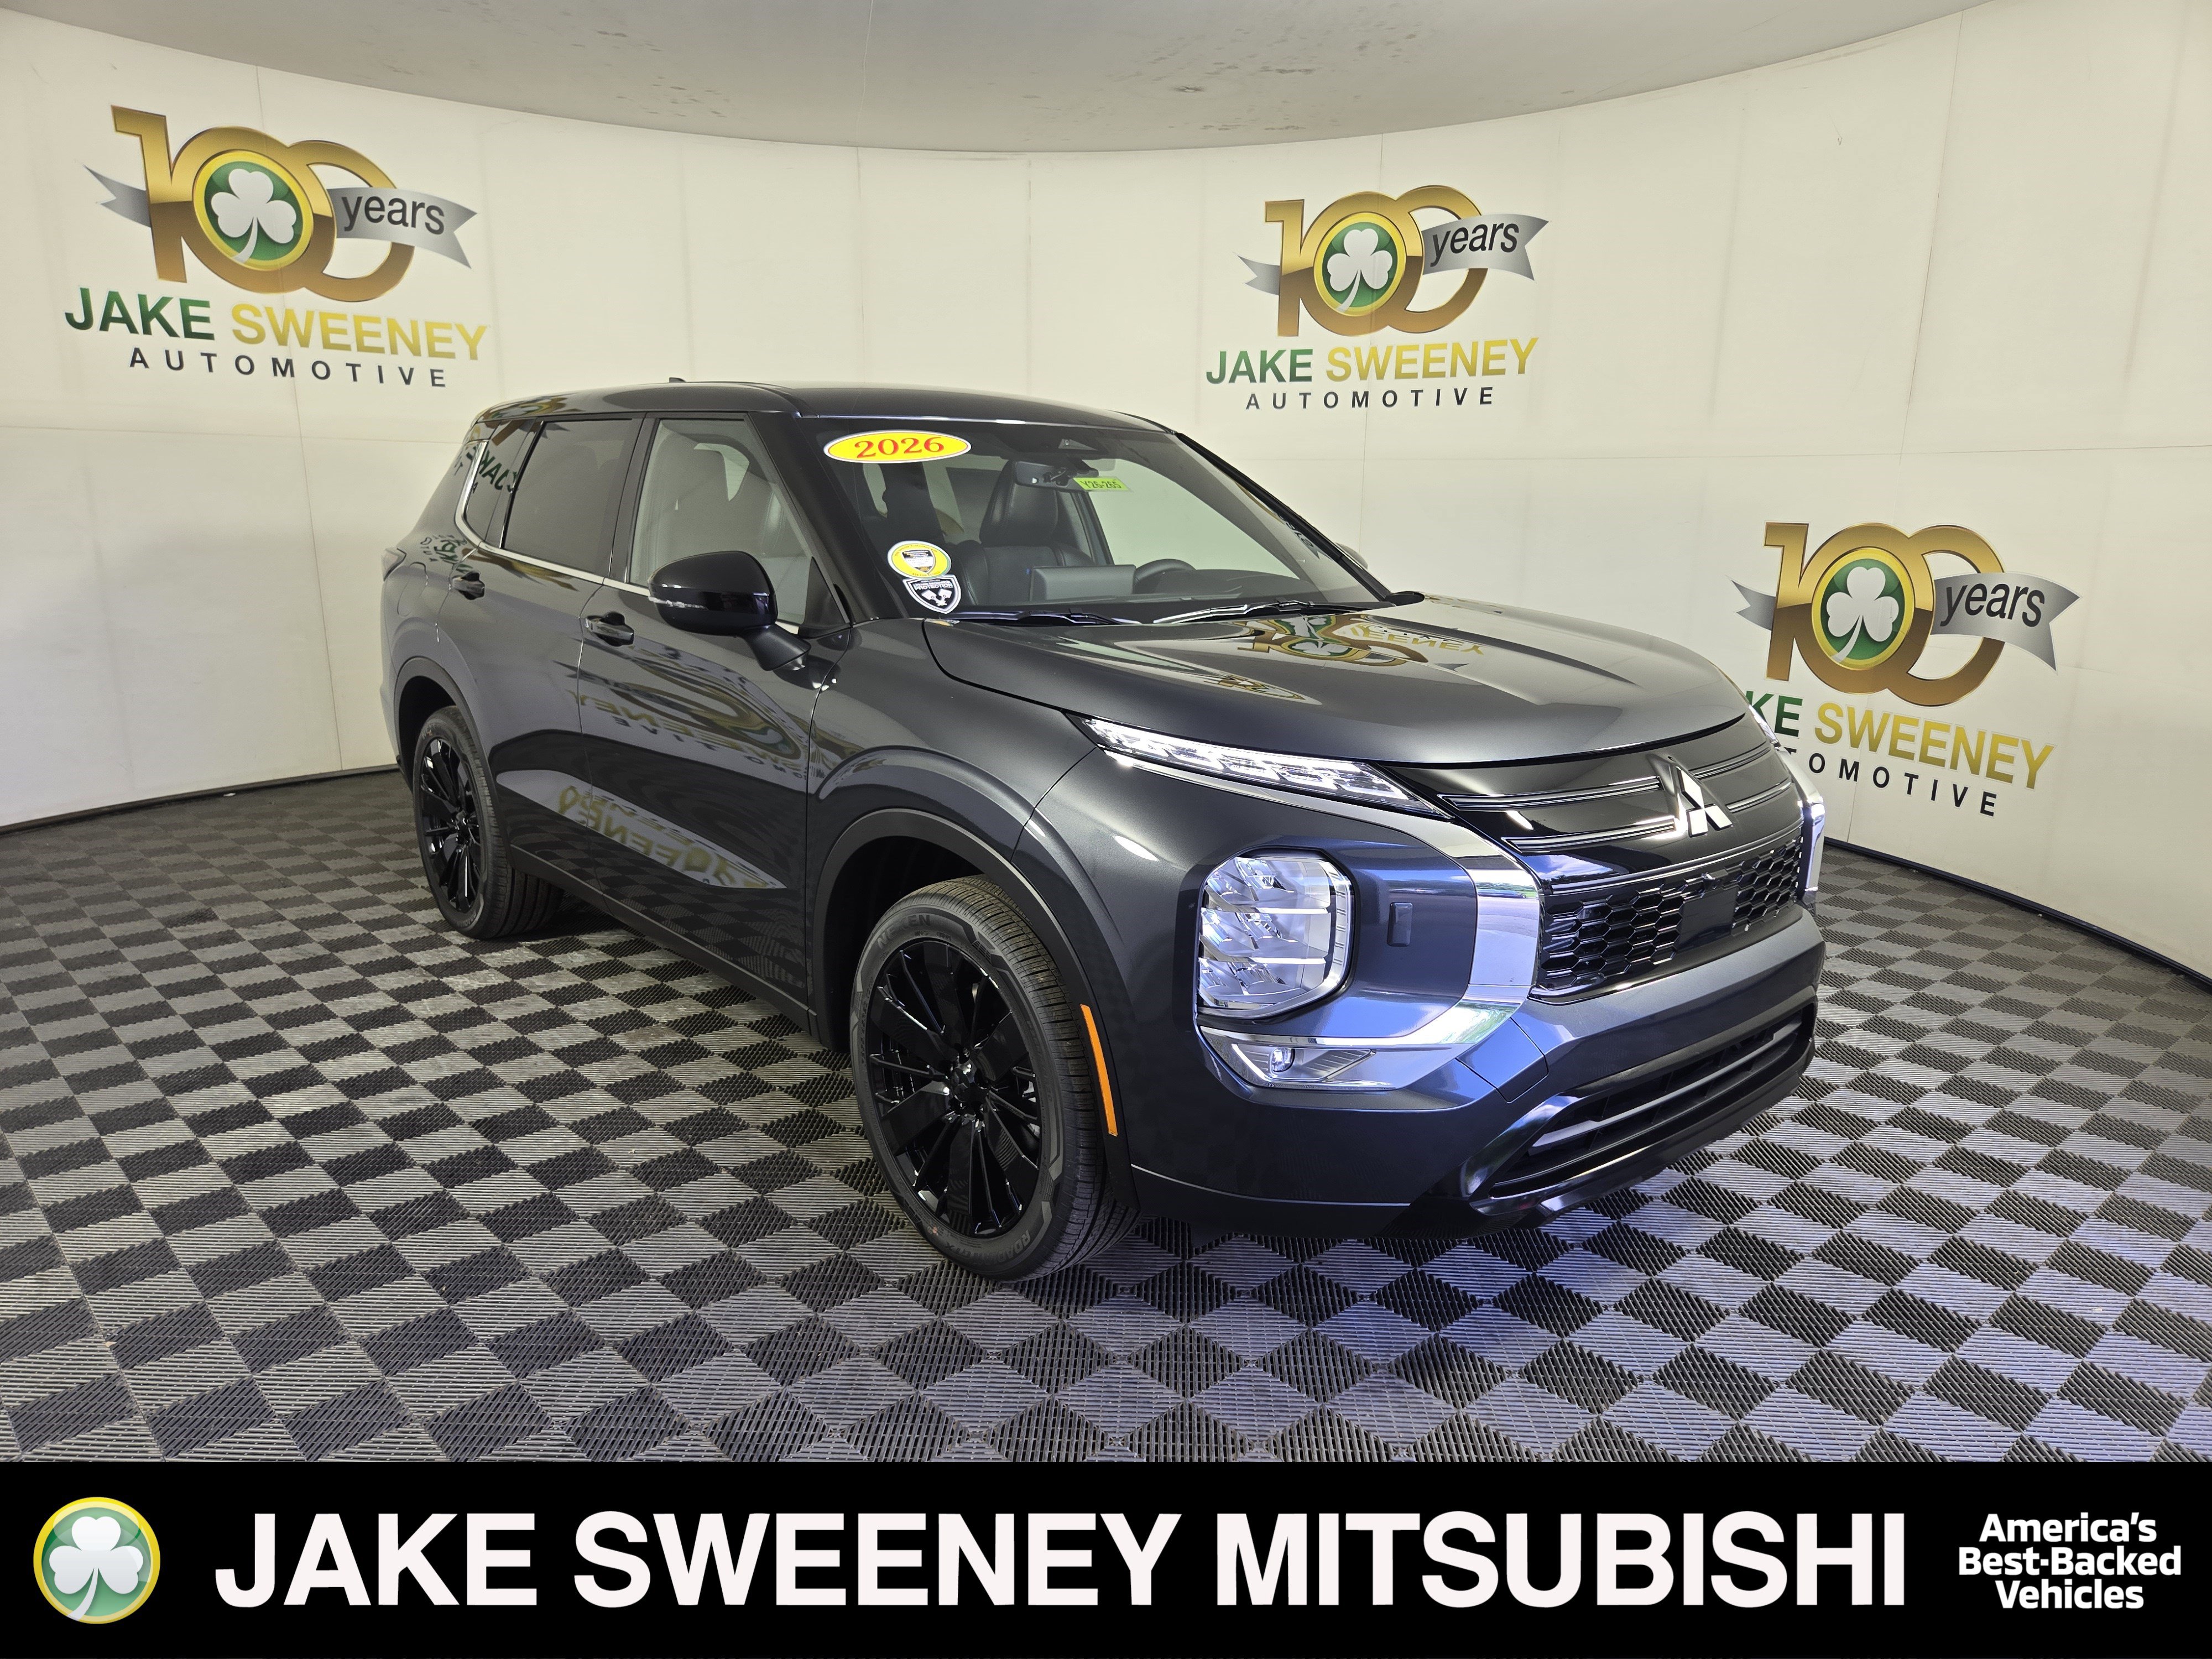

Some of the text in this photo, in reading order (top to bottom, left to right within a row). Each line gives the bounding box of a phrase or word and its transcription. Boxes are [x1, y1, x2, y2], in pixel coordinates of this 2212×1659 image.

[112, 105, 415, 302] 100
[341, 195, 445, 234] years
[1264, 185, 1489, 337] 100
[1430, 222, 1519, 268] years
[64, 287, 488, 361] JAKE SWEENEY
[129, 346, 446, 388] AUTOMOTIVE
[1206, 337, 1539, 384] JAKE SWEENEY
[1246, 387, 1494, 410] AUTOMOTIVE
[854, 437, 945, 459] 2026
[1764, 522, 2006, 707] 100
[1940, 582, 2046, 628] years
[1746, 691, 2054, 790] KE SWEENEY
[1784, 747, 1997, 817] OMOTIVE
